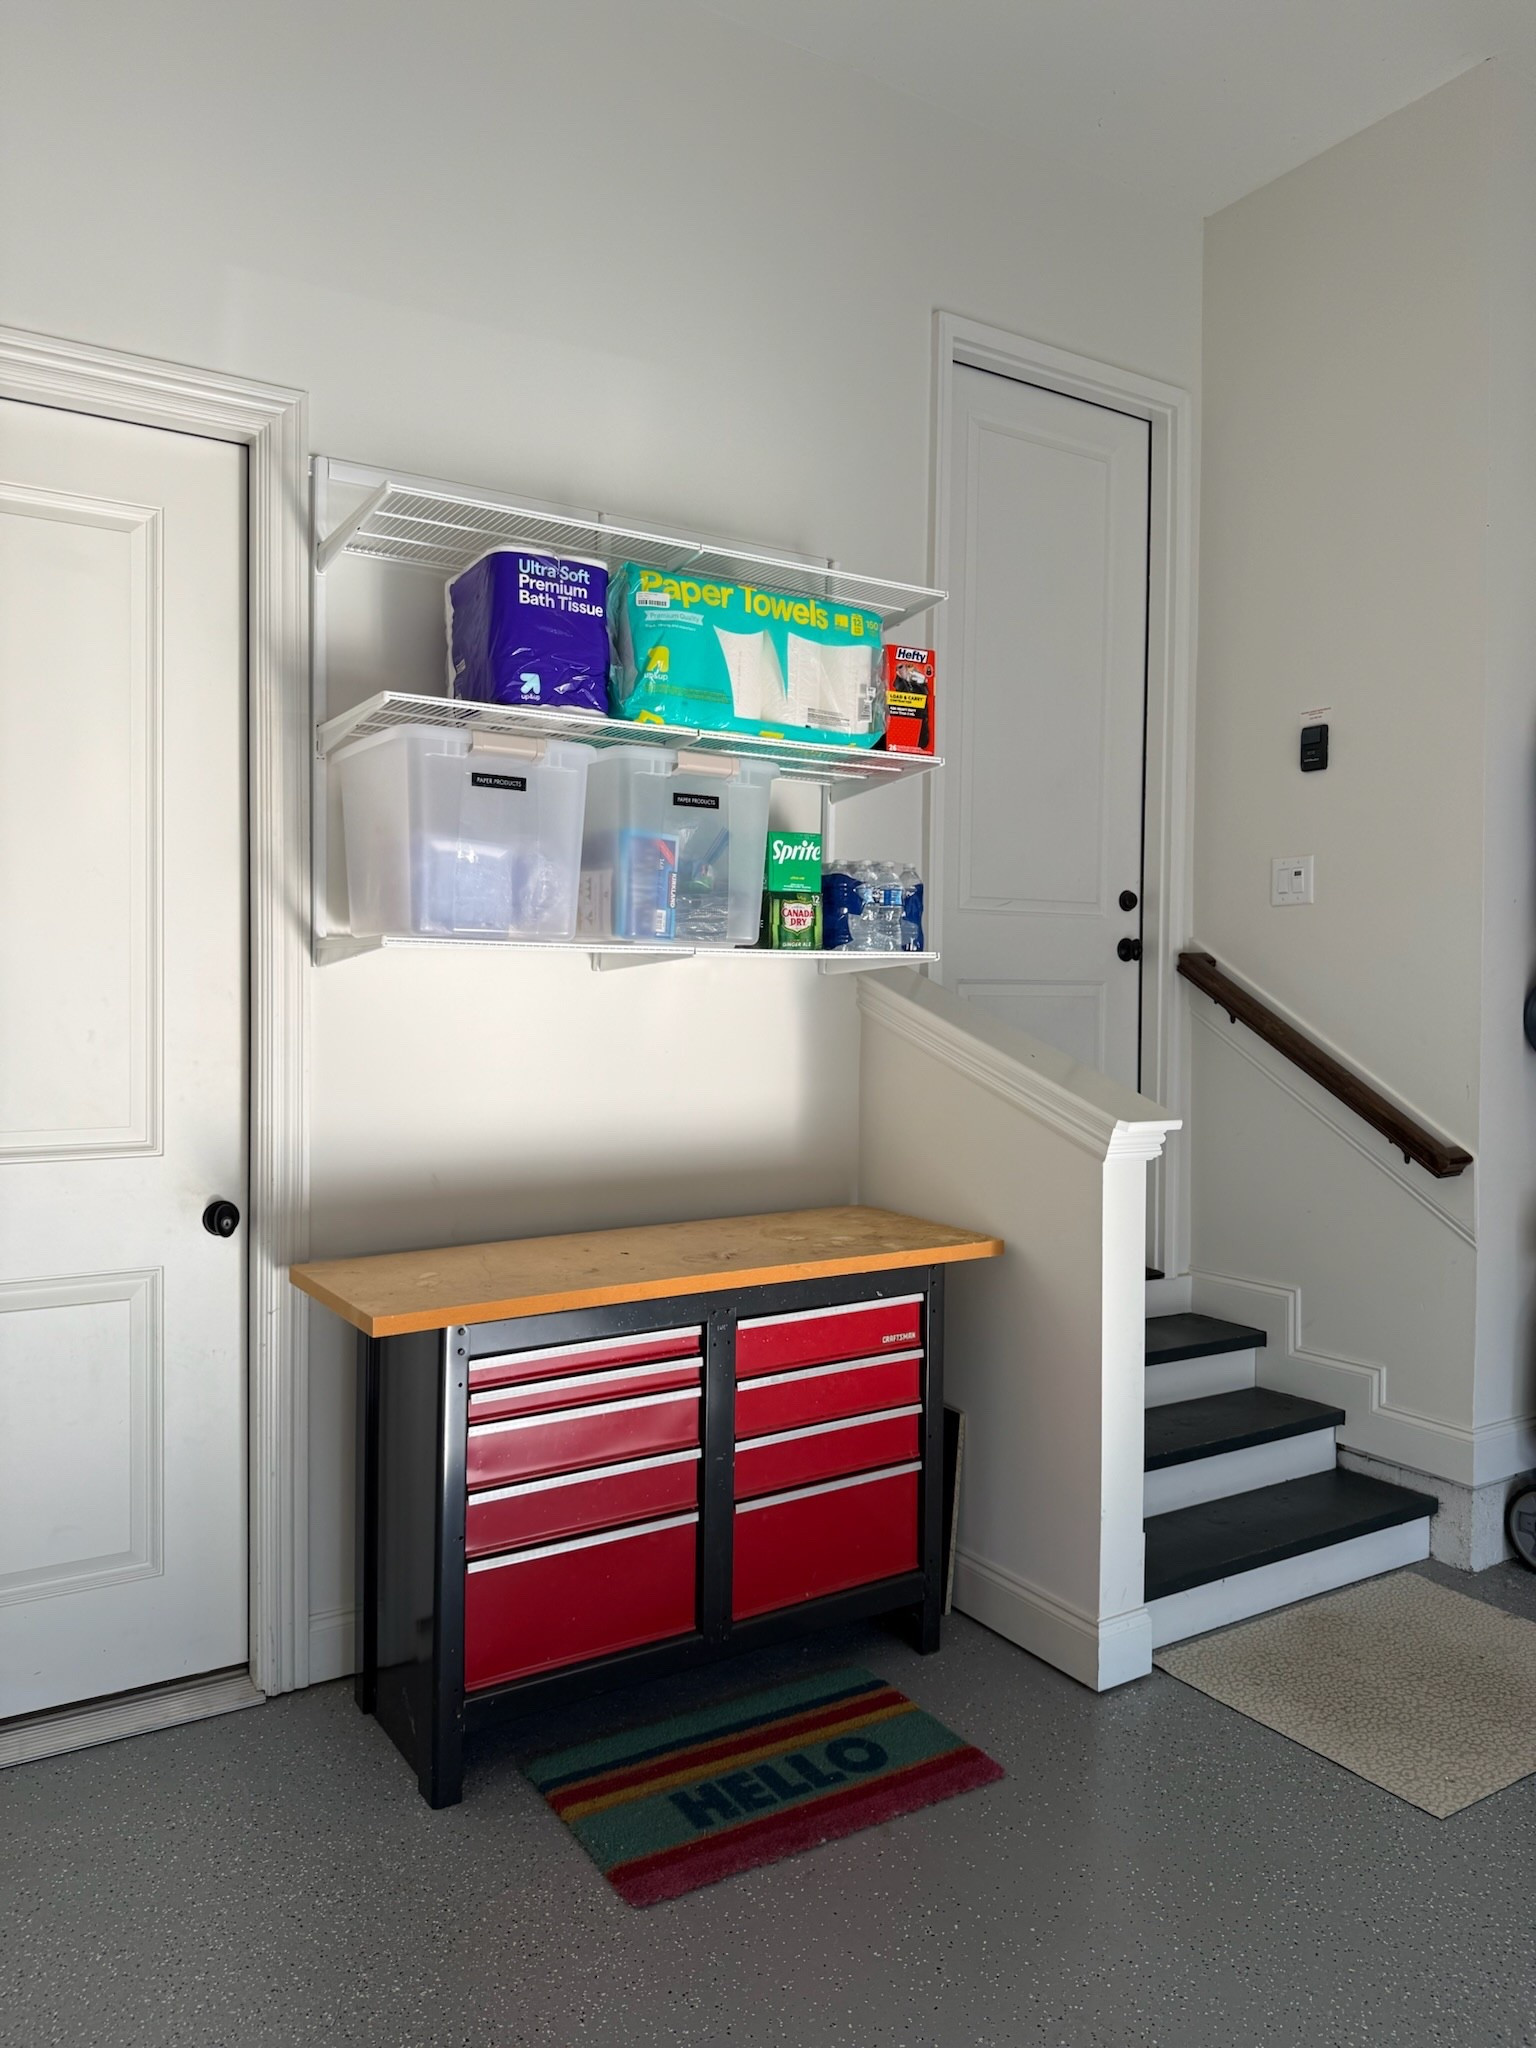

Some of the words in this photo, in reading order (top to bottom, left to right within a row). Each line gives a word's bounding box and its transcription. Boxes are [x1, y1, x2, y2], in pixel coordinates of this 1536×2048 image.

[518, 558, 556, 578] Ultra
[559, 566, 591, 585] Soft
[518, 573, 588, 599] Premium
[519, 589, 556, 609] Bath
[558, 597, 604, 618] Tissue
[640, 570, 734, 609] Paper
[737, 582, 829, 630] Towels
[650, 612, 679, 620] Premium
[679, 612, 700, 623] Quality
[897, 648, 926, 663] Hefty
[476, 776, 493, 785] PAPER
[493, 778, 522, 788] PRODUCTS
[676, 796, 691, 804] PAPER
[691, 797, 716, 806] PRODUCTS
[772, 839, 821, 865] Sprite
[669, 873, 678, 909] KIRKLAND
[811, 895, 821, 904] 12
[782, 908, 815, 918] CANADA
[789, 917, 808, 927] DRY
[882, 1331, 916, 1344] CRAFTSMAN
[667, 1736, 889, 1831] HELLO
